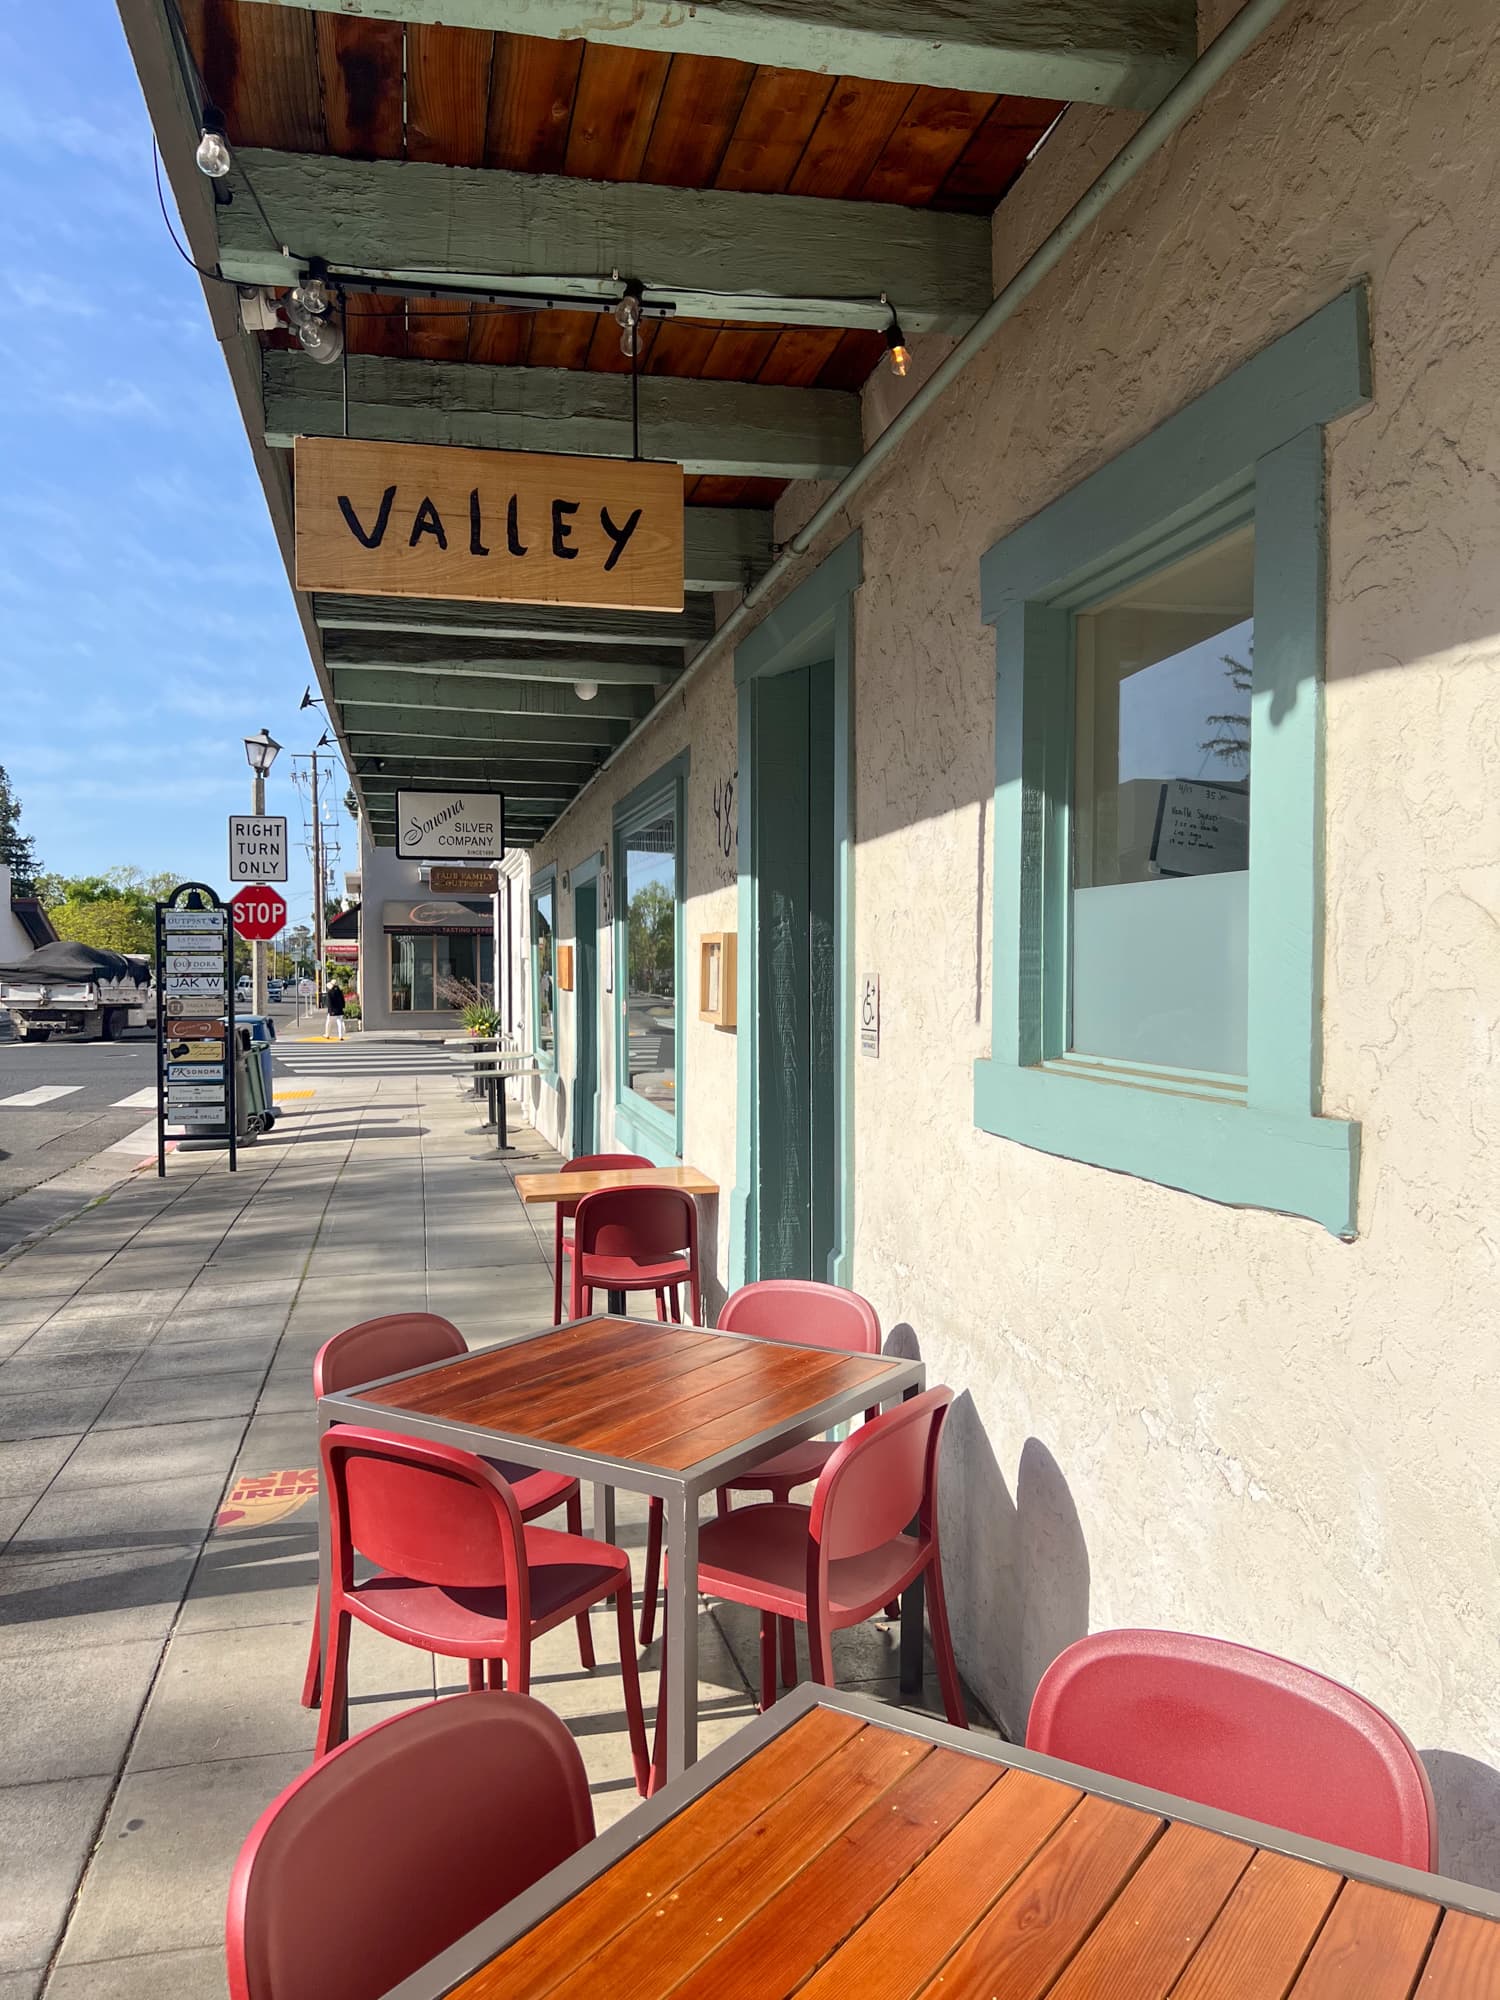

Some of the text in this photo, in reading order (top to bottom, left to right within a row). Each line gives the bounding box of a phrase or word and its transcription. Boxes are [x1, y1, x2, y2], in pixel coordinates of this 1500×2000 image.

[337, 485, 642, 572] VALLEY
[713, 771, 738, 858] 48
[403, 799, 465, 846] Sonoma
[454, 822, 494, 833] SILVER
[235, 823, 282, 837] RIGHT
[438, 835, 494, 846] COMPANY
[237, 843, 280, 855] TURN
[238, 861, 279, 874] ONLY
[233, 902, 284, 924] STOP
[170, 978, 220, 988] JAK W
